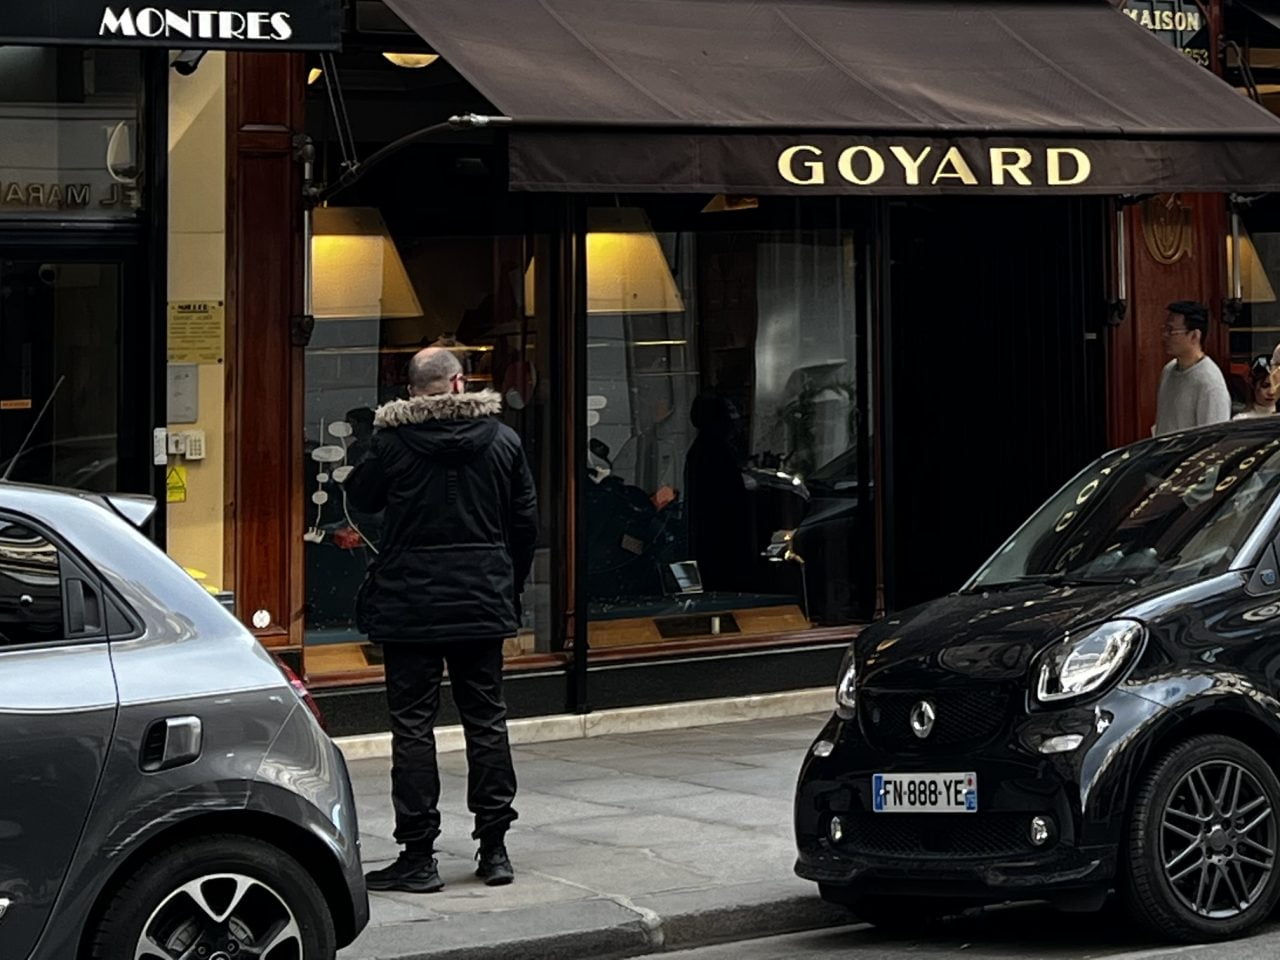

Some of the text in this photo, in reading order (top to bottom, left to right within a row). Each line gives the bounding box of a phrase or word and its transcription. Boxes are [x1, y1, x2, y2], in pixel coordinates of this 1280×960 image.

[99, 6, 293, 41] MONTRES
[777, 145, 1092, 186] GOYARD
[884, 780, 965, 806] FN-888-YE
